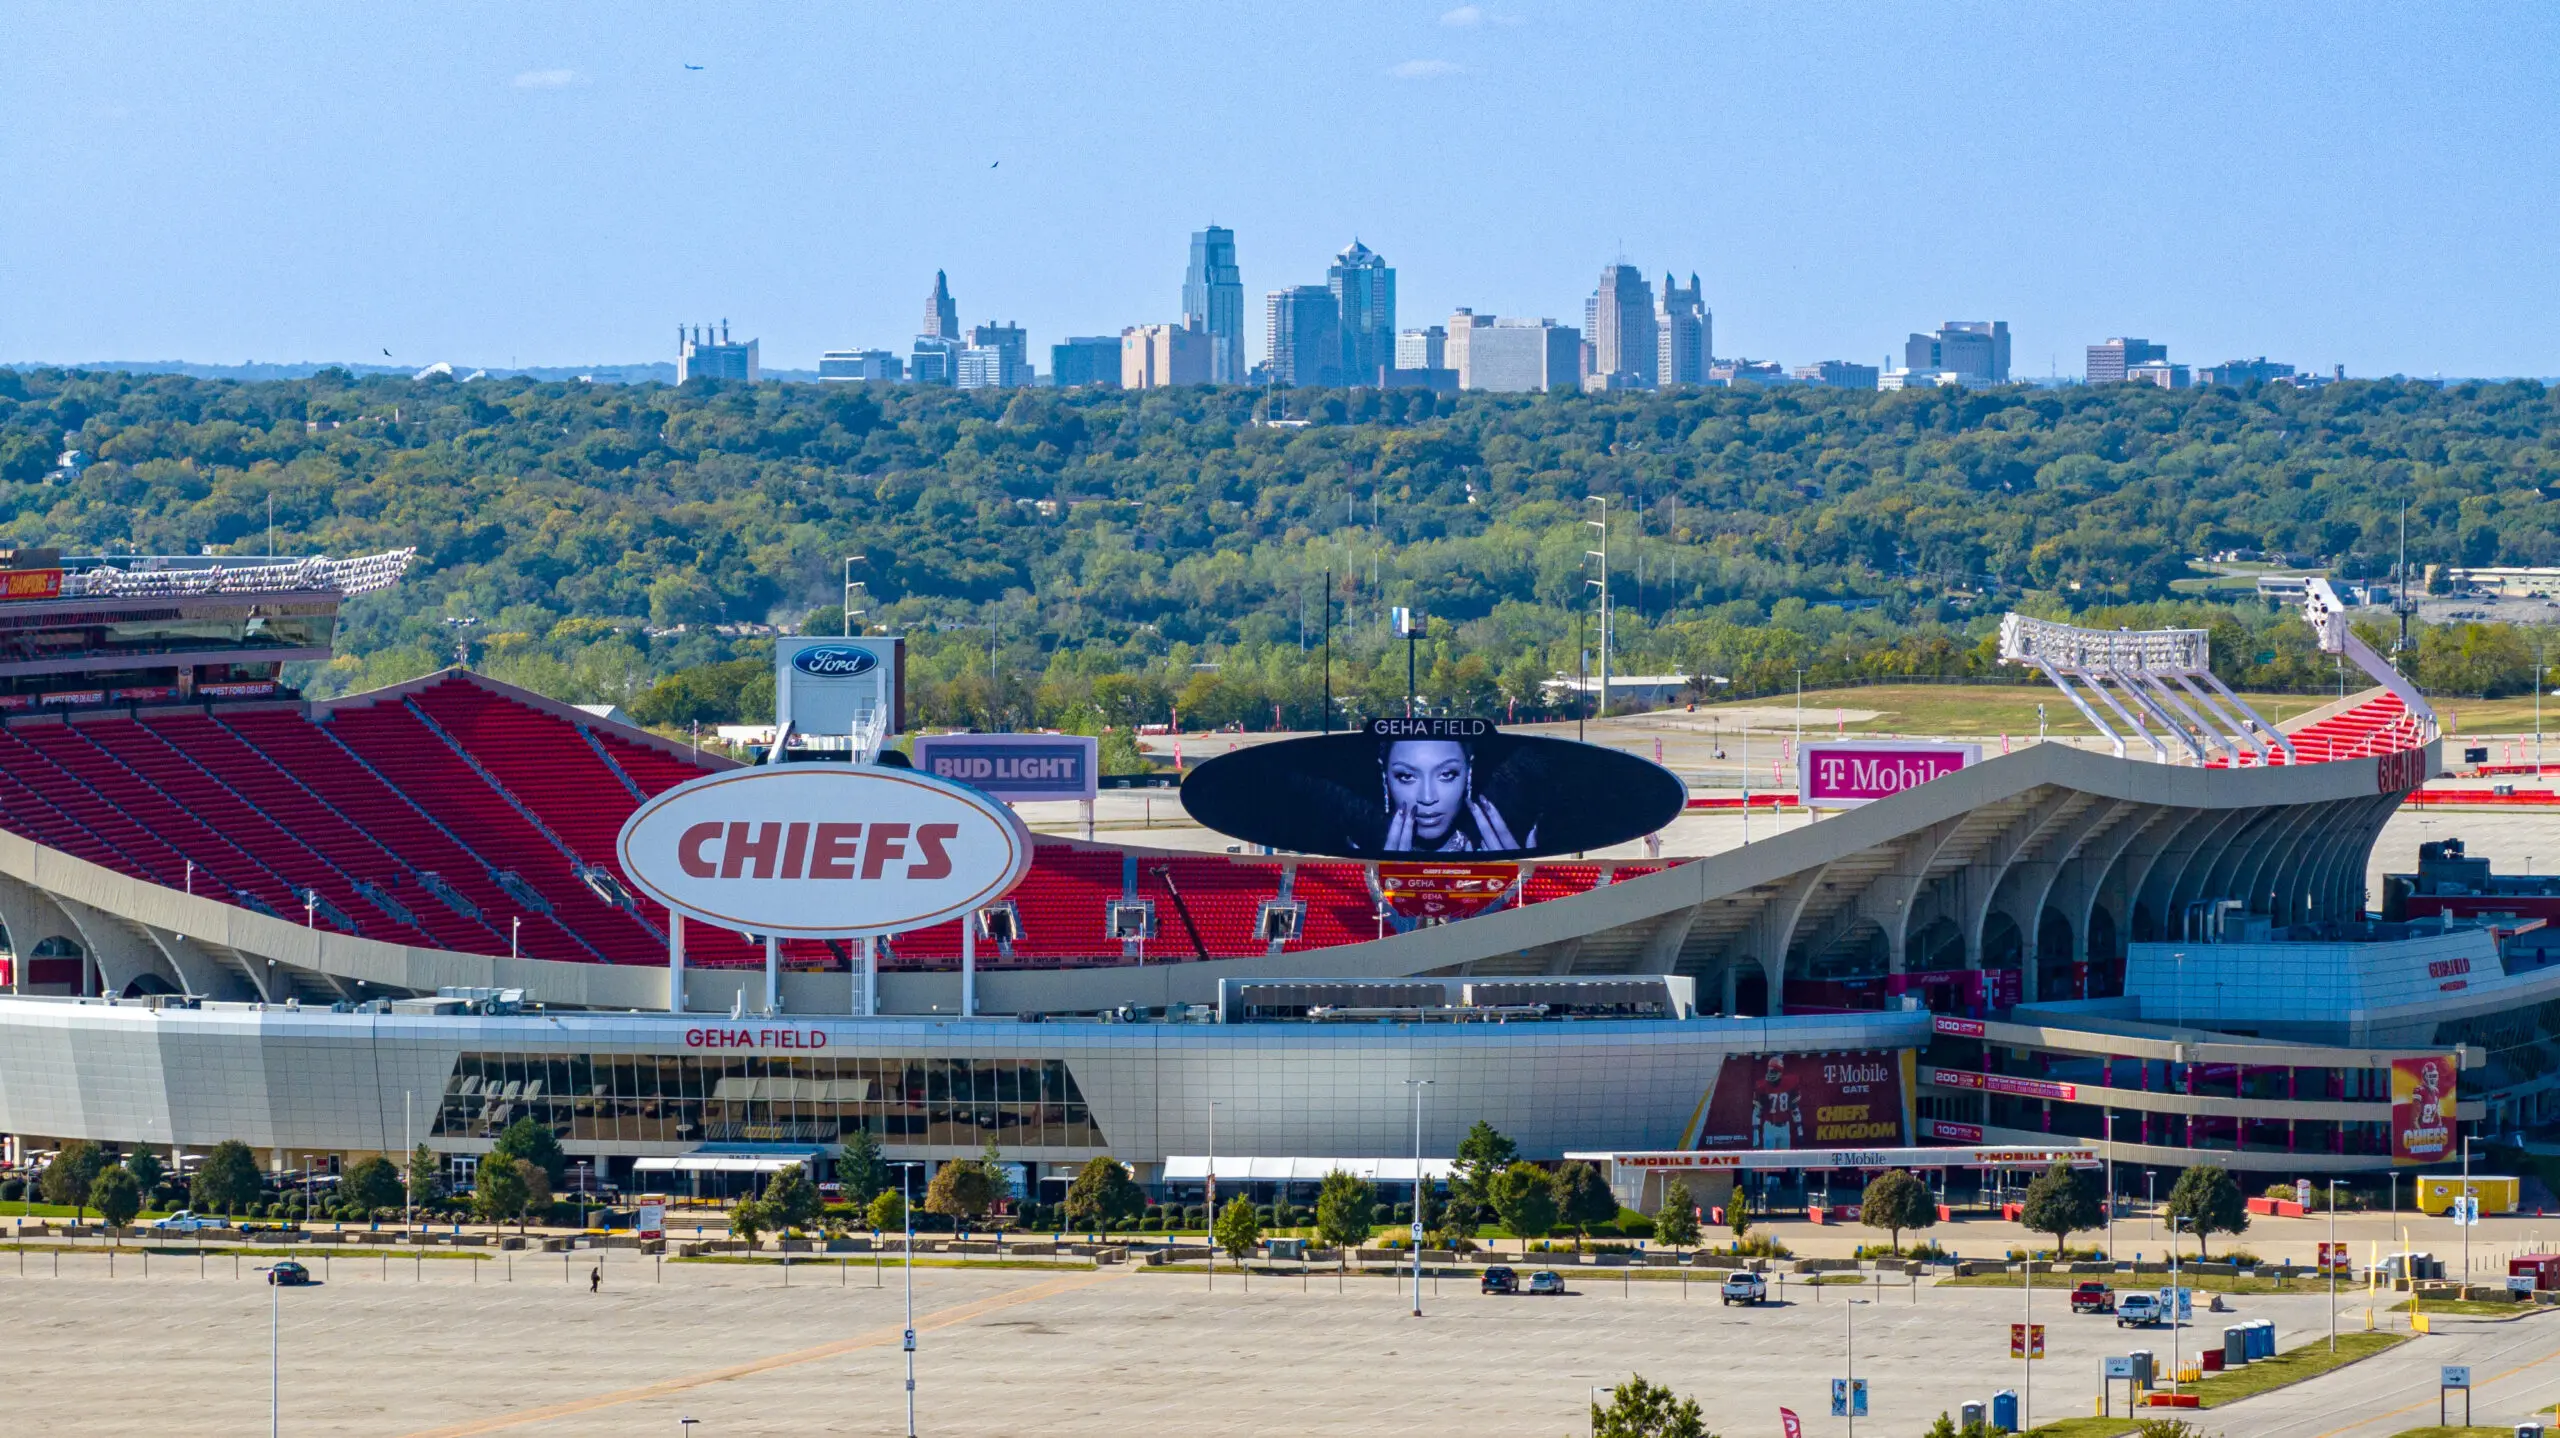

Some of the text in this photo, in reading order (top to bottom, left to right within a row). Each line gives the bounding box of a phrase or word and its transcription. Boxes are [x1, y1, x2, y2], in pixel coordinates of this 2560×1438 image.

[809, 649, 861, 672] Ford
[1374, 720, 1486, 735] GEHA FIELD
[934, 758, 1076, 779] BUD LIGHT
[678, 821, 960, 880] CHIEFS
[1407, 879, 1436, 888] GEHA
[1422, 893, 1443, 901] GEHA
[1937, 1020, 1960, 1031] 300
[685, 1028, 827, 1049] GEHA FIELD
[1936, 1072, 1958, 1083] 200
[1842, 1085, 1870, 1093] GATE
[1768, 1093, 1789, 1114] 78
[1816, 1104, 1870, 1122] CHIEFS
[1816, 1122, 1897, 1141] KINGDOM
[1937, 1125, 1957, 1136] 100
[1618, 1155, 1741, 1167] T-MOBILE GATE
[1974, 1152, 2047, 1161] T-MOBILE
[819, 1182, 840, 1191] GATE
[1413, 1223, 1420, 1232] C
[904, 1329, 914, 1339] C
